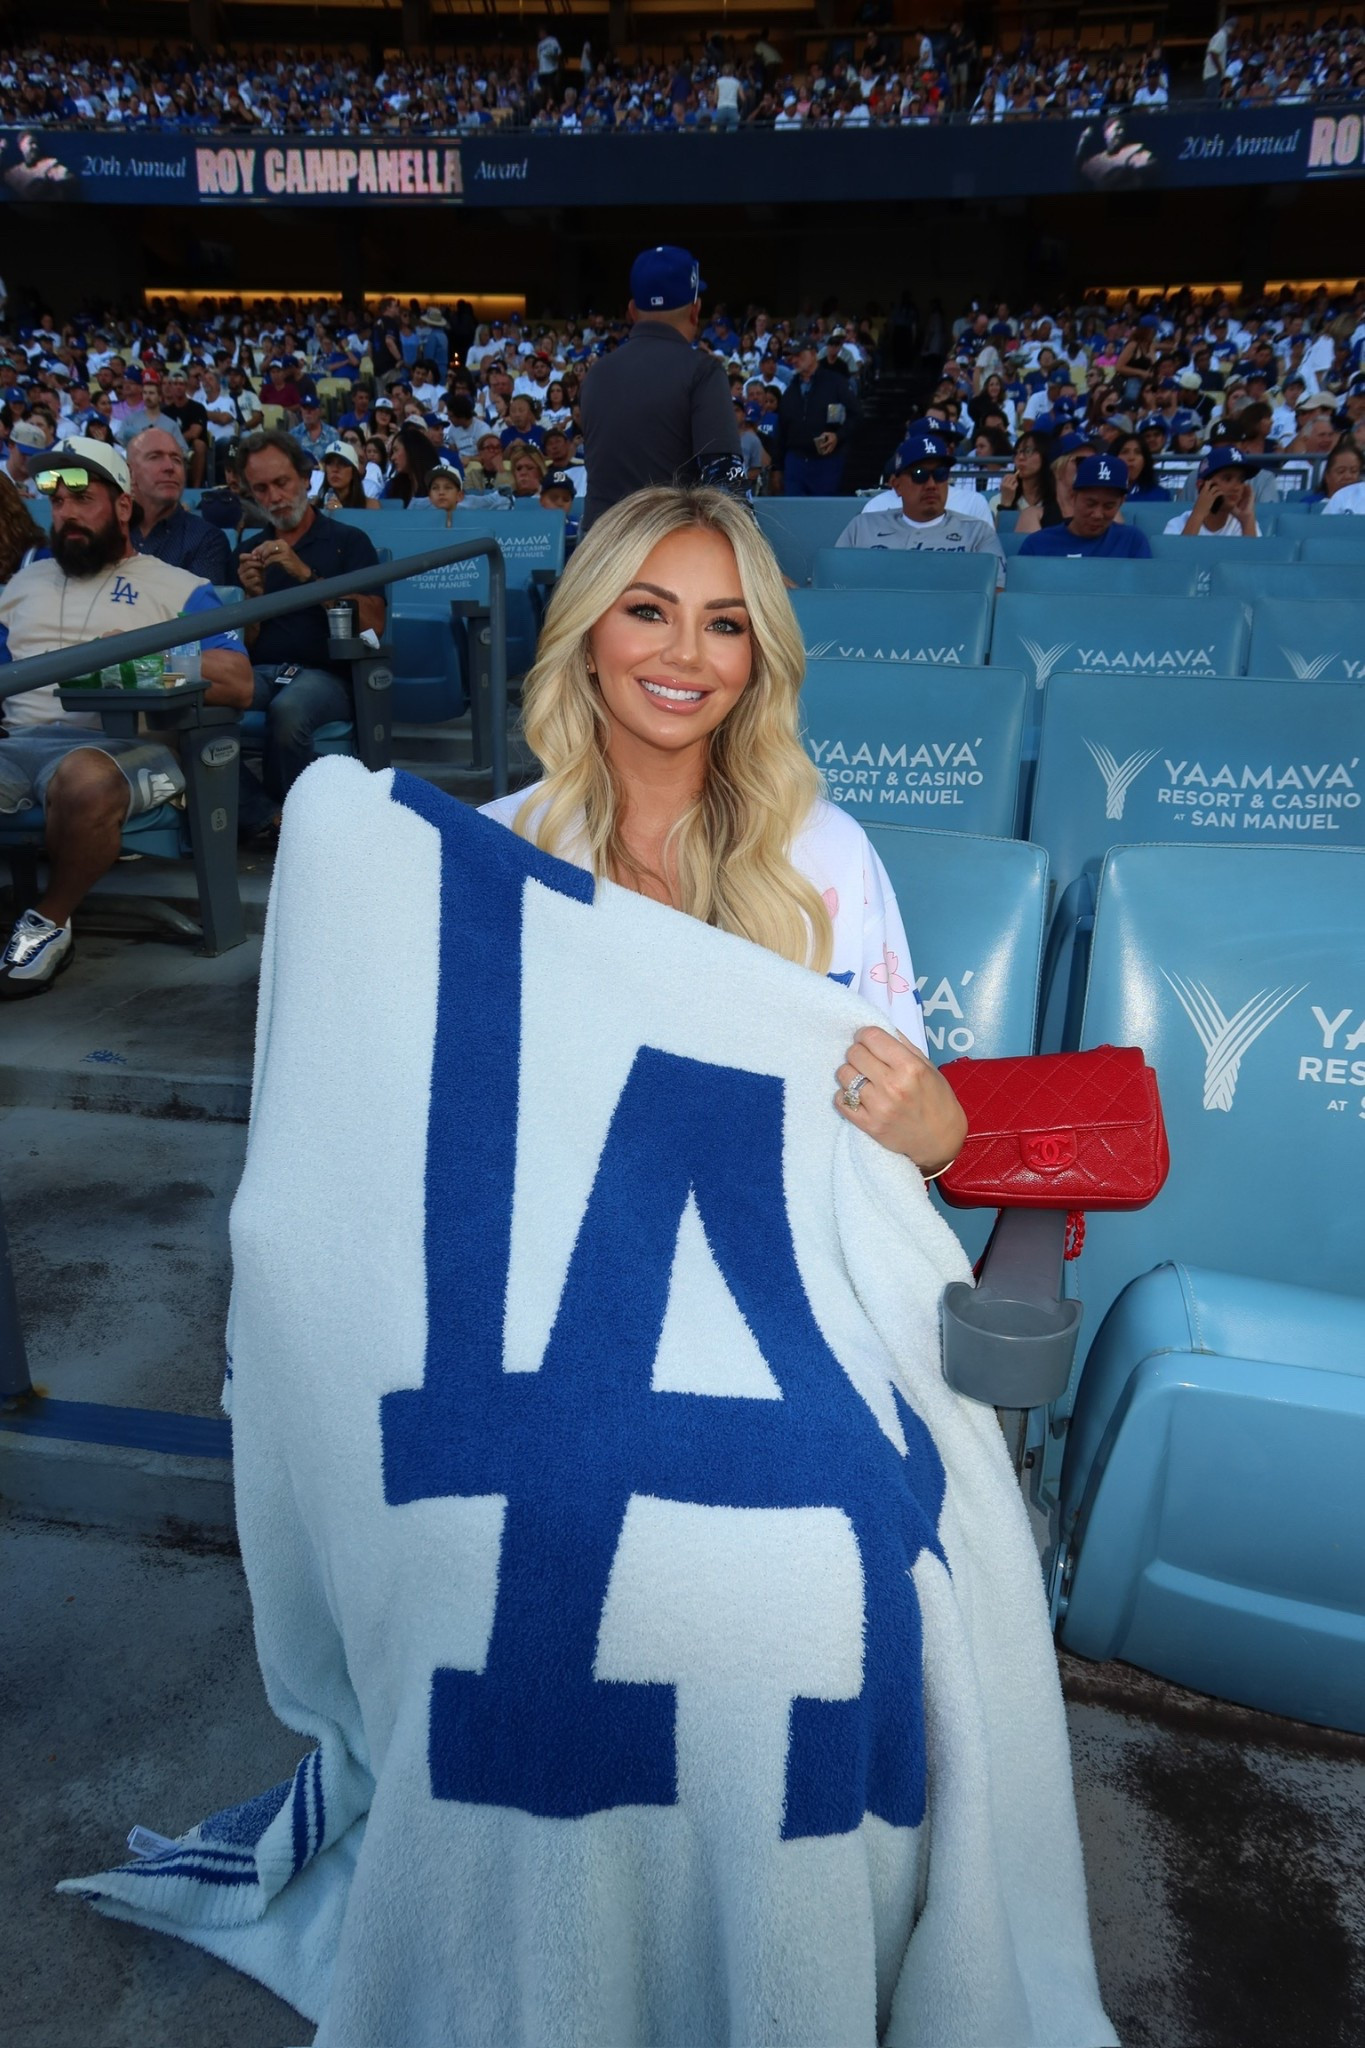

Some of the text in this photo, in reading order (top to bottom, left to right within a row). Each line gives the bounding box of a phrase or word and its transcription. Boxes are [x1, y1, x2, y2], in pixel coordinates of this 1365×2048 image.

[1178, 115, 1365, 168] 20th Annual RO
[82, 149, 528, 194] 20th Annual ROY CAMPANELLA Award
[923, 438, 937, 454] LA
[1098, 461, 1111, 480] LA
[495, 533, 550, 546] AAMAVA'
[111, 576, 138, 605] LA
[818, 767, 983, 786] ESORT & CASINO
[832, 787, 964, 805] SAN MANUEL
[1157, 788, 1361, 809] RESORT & CASINO
[1173, 810, 1339, 829] AT SAN MANUEL
[1327, 1100, 1348, 1111] AT
[379, 766, 952, 1842] LA
